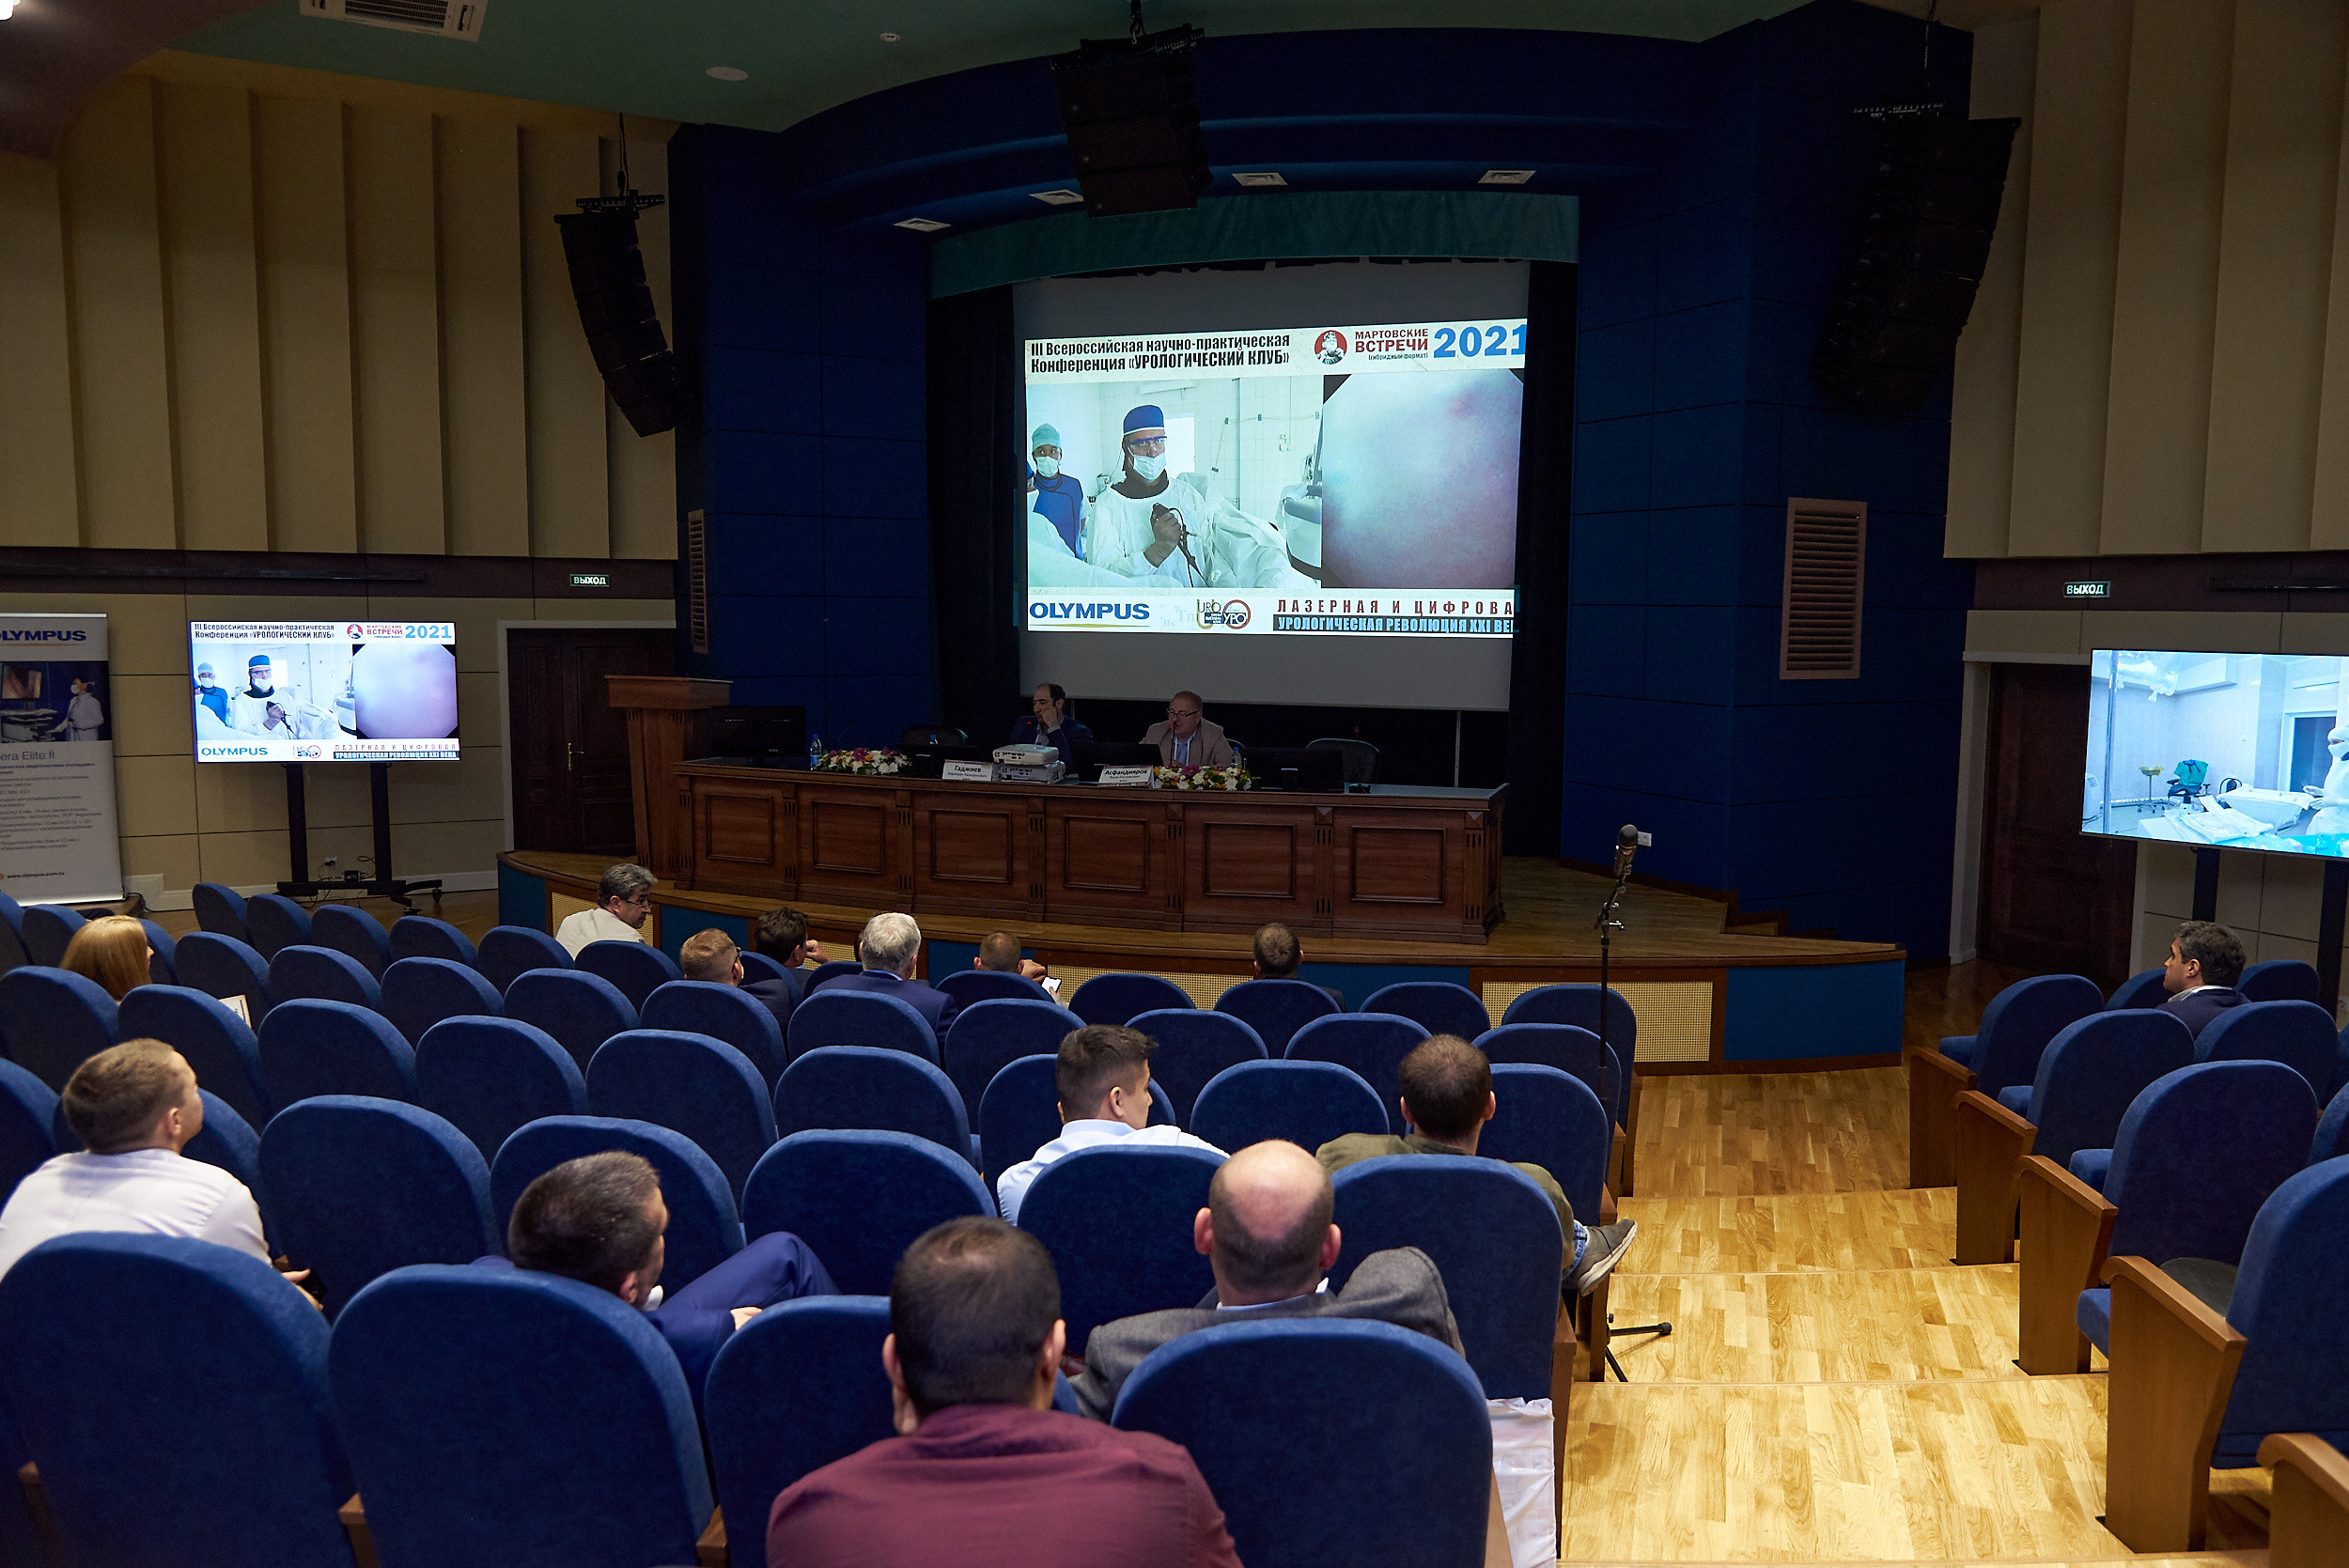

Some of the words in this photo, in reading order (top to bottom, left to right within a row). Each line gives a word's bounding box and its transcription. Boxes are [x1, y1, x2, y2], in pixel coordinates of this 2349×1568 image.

[1355, 329, 1428, 340] МАРТОВСКИЕ
[1433, 324, 1527, 358] 2021
[1031, 343, 1043, 356] III
[1046, 339, 1143, 356] Всероссийская
[1146, 334, 1290, 352] научно-практическая
[1355, 338, 1428, 353] ВСТРЕЧИ
[1031, 357, 1126, 374] Конференция
[1128, 348, 1245, 369] «УРОЛОГИЧЕСКИЙ
[1248, 349, 1289, 365] КЛУБ»
[573, 576, 606, 584] ВЫХОД
[2066, 584, 2105, 595] ВЫХОД
[1029, 602, 1150, 620] OLYMPUS
[1277, 599, 1378, 613] ЛАЗЕРНАЯ
[1392, 600, 1401, 613] И
[1278, 616, 1383, 631] УРОЛОГИЧЕСКАЯ
[1386, 618, 1467, 633] РЕВОЛЮЦИЯ
[1469, 620, 1491, 632] XXI
[0, 630, 87, 642] LYMPUS
[194, 630, 248, 639] Конференция
[405, 625, 452, 639] 2021
[22, 751, 46, 760] Elite
[201, 747, 269, 756] OLYMPUS
[954, 765, 982, 774] Гаджиев
